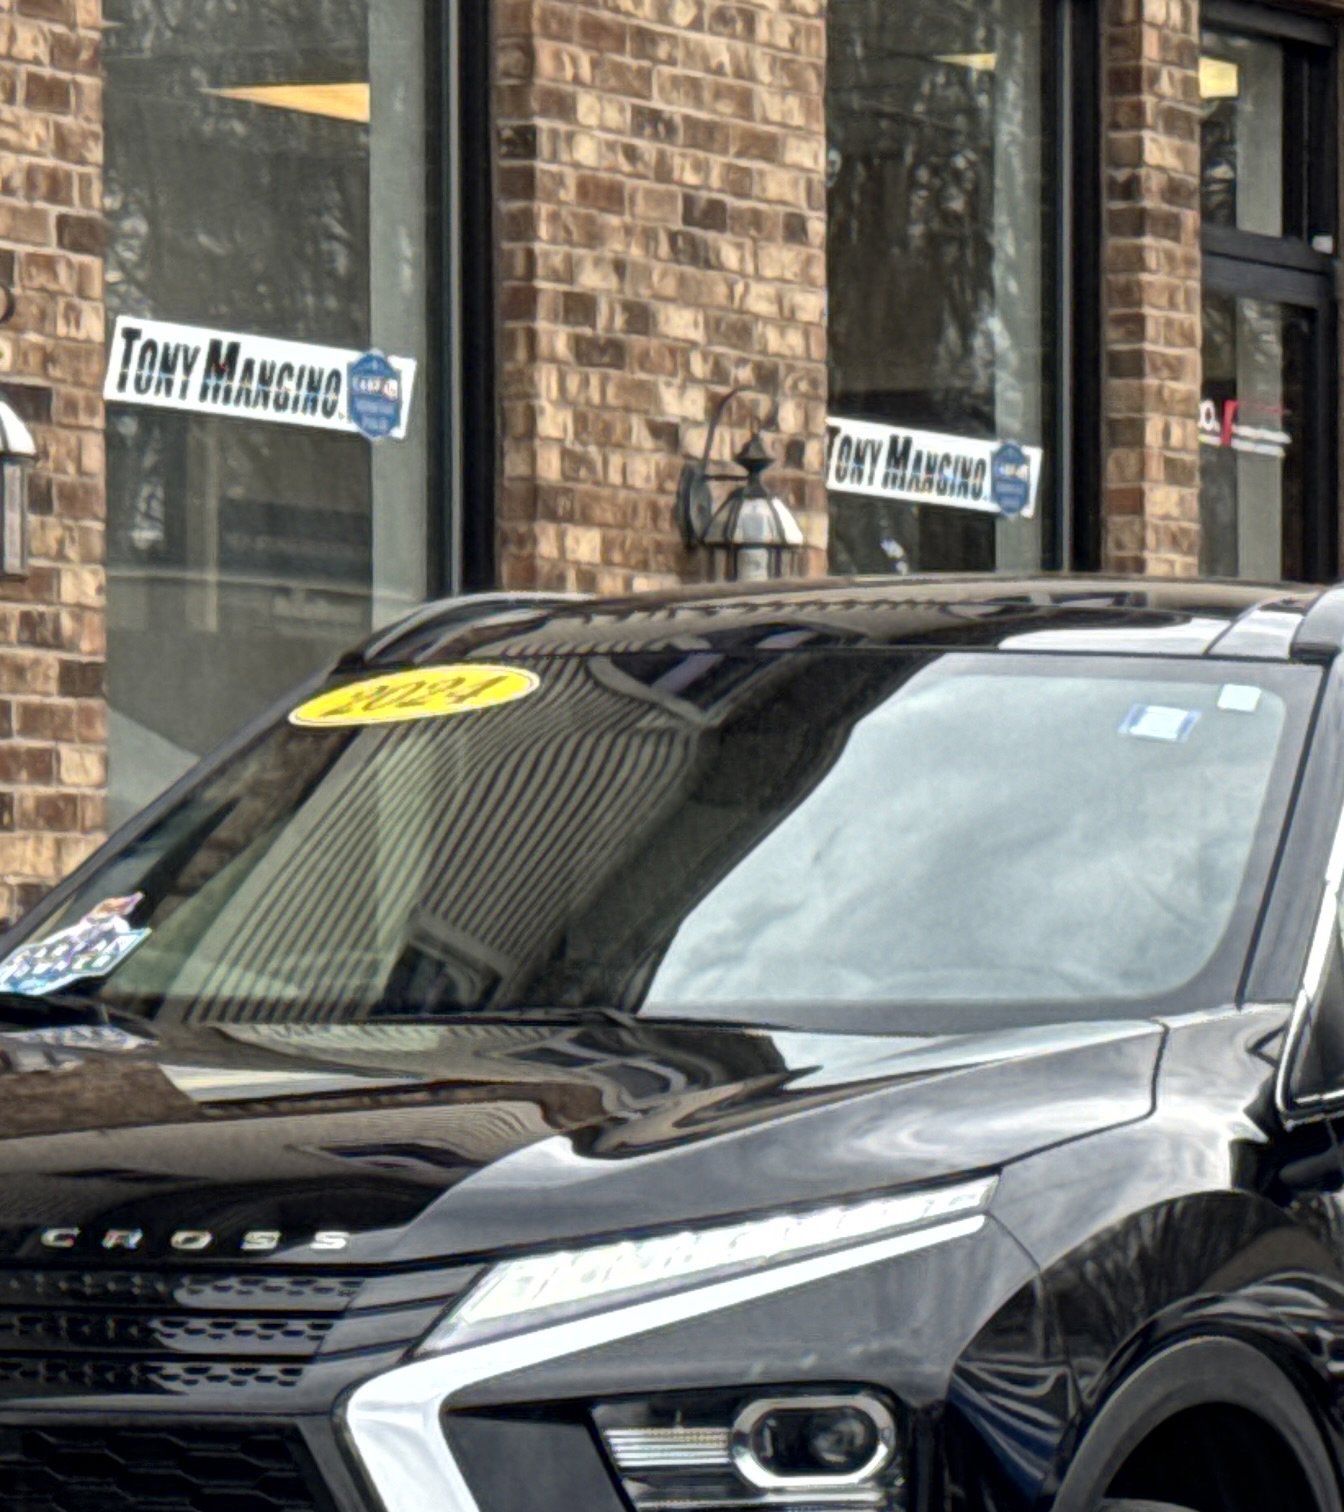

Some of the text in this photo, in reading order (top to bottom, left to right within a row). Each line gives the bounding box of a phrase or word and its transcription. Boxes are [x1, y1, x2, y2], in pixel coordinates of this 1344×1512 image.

[116, 327, 201, 401] TONY
[318, 674, 508, 718] 2024
[41, 1226, 351, 1251] CROSS
